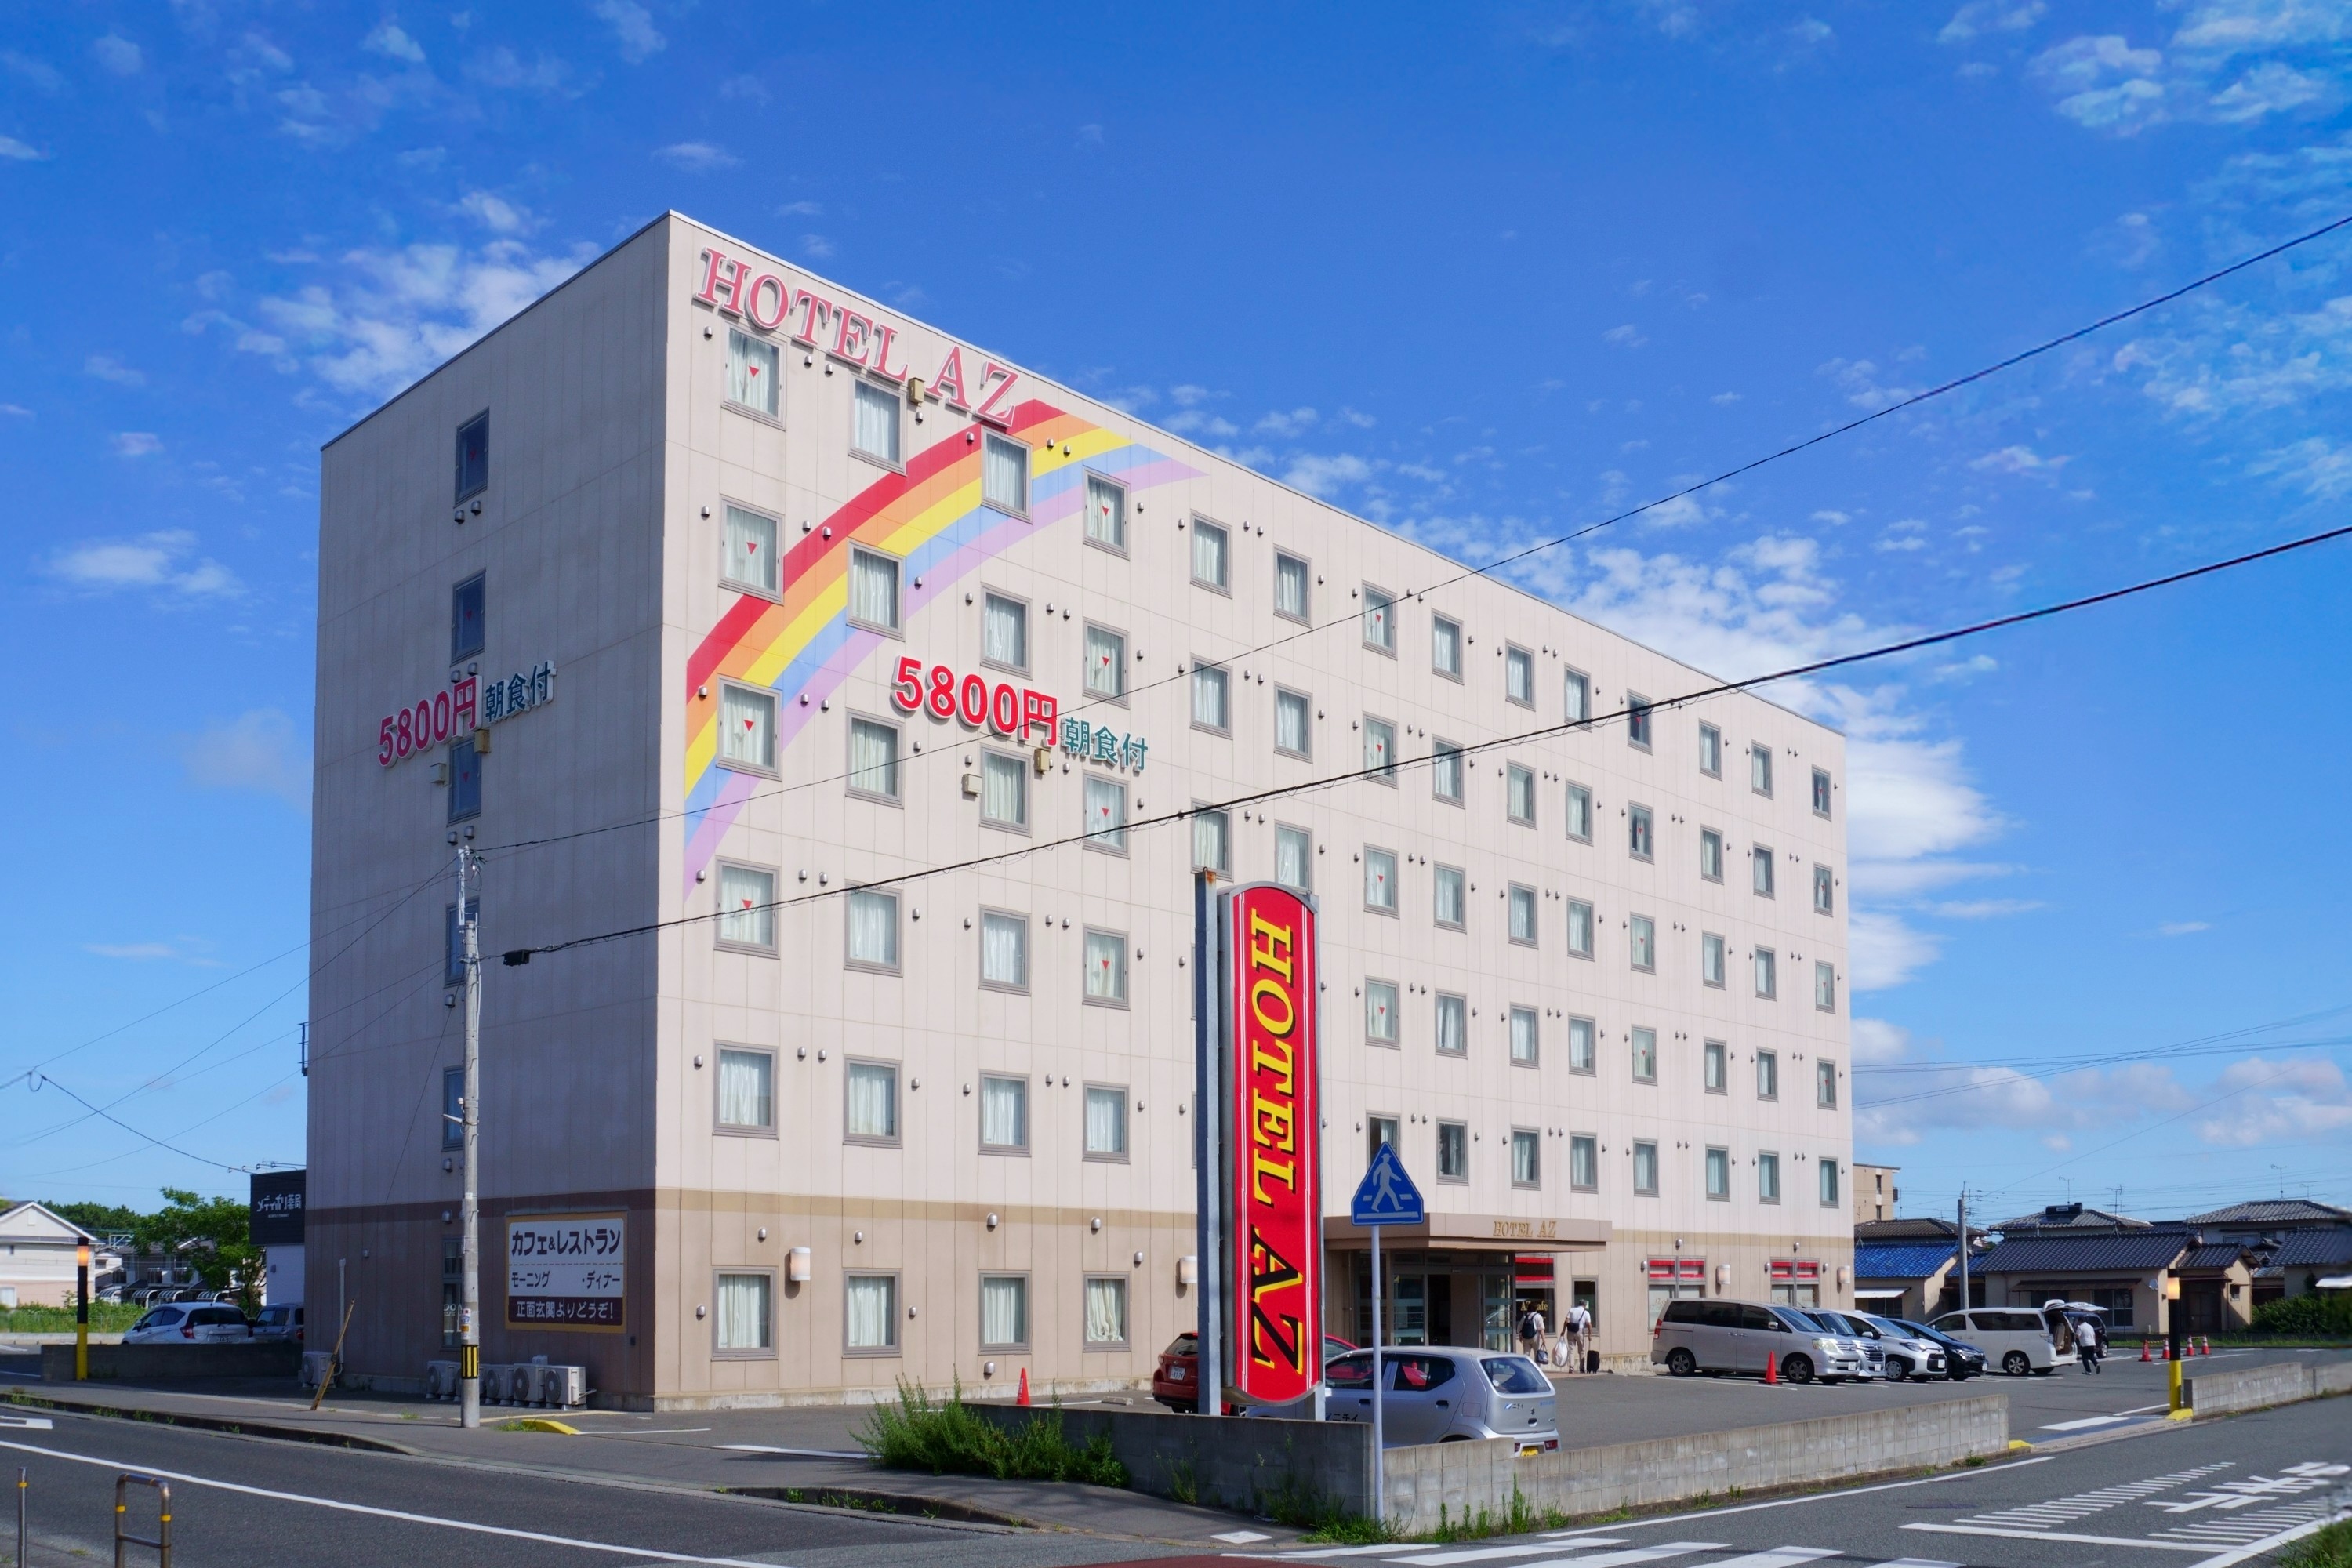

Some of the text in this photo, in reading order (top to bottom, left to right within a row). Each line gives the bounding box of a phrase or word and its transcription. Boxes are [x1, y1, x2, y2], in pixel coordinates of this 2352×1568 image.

[693, 246, 1020, 428] HOTEL AZ
[378, 661, 555, 768] 5800円 朝食付
[891, 655, 1149, 772] 5800円 朝食付
[1250, 907, 1304, 1376] HOTEL AZ
[511, 1229, 621, 1256] カフェ&レストラン
[1493, 1220, 1557, 1238] HOTEL AZ
[511, 1270, 551, 1288] モーニング
[1536, 1300, 1548, 1311] afe
